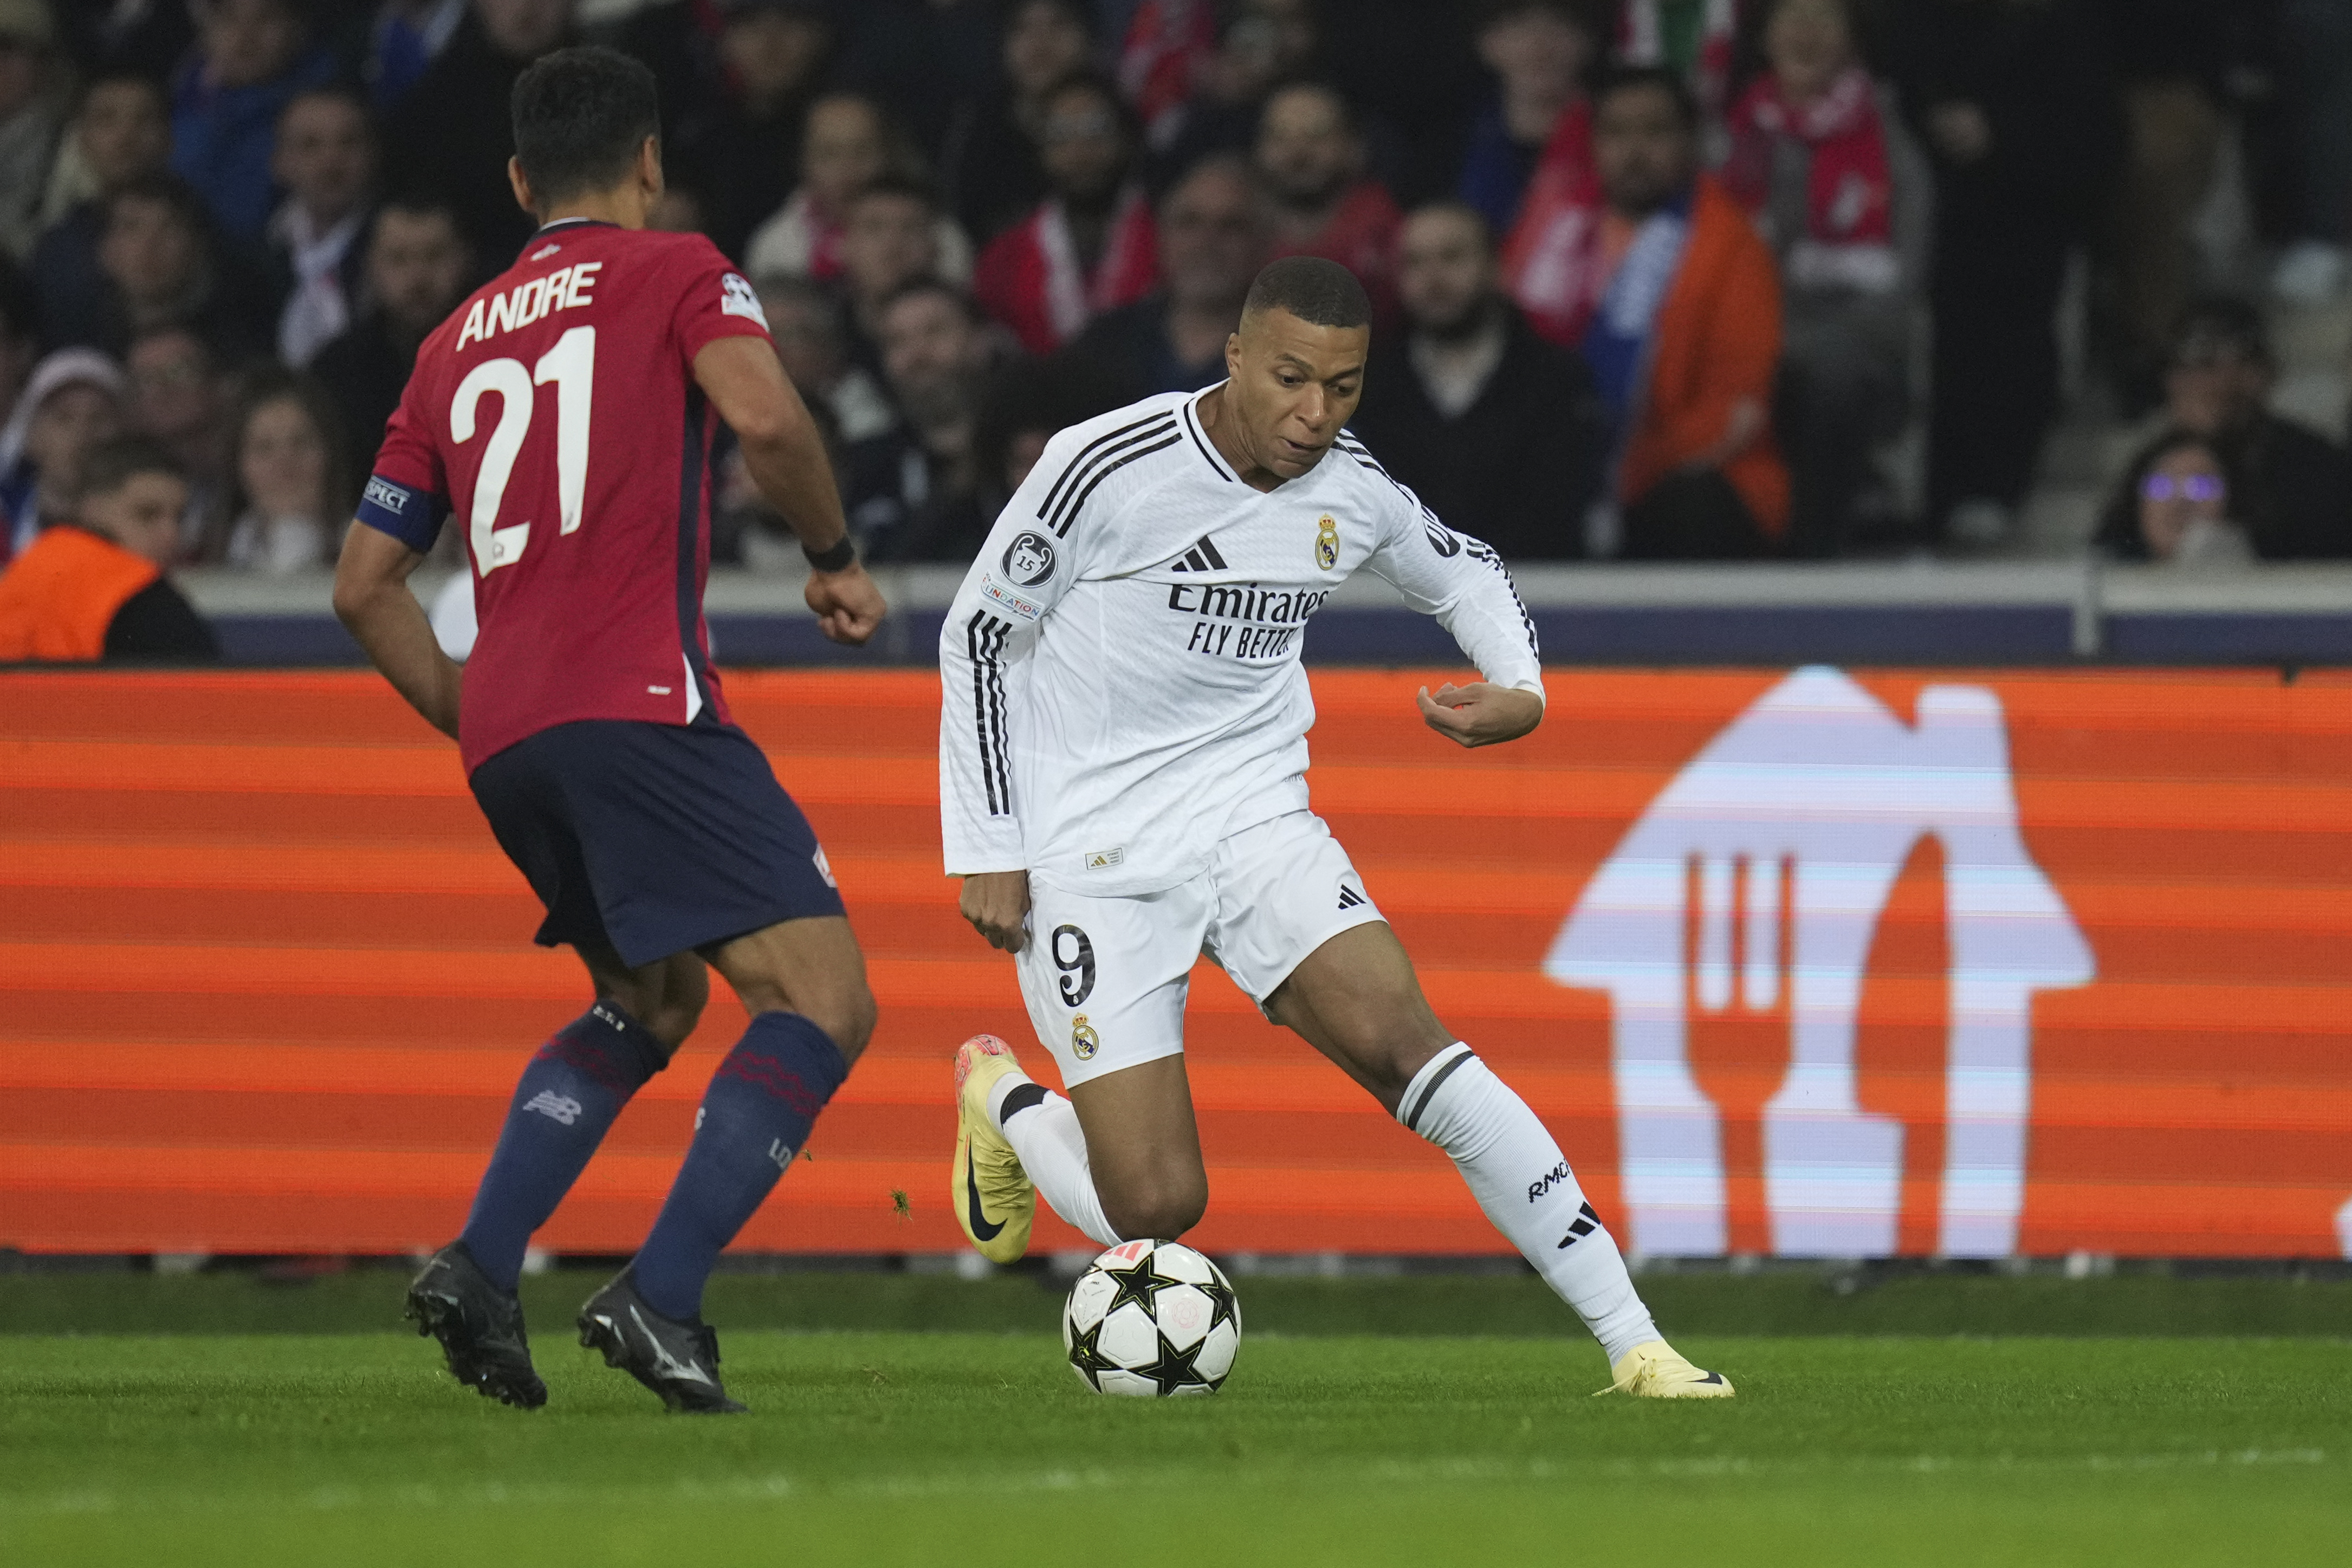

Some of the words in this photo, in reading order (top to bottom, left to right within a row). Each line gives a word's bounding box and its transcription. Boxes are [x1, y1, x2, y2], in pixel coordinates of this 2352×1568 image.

[456, 262, 602, 352] ANDRE
[450, 326, 595, 578] 21
[1016, 555, 1035, 571] 15
[982, 576, 1040, 616] UNDATION
[1188, 622, 1232, 655] FLY
[1052, 924, 1095, 1008] 9
